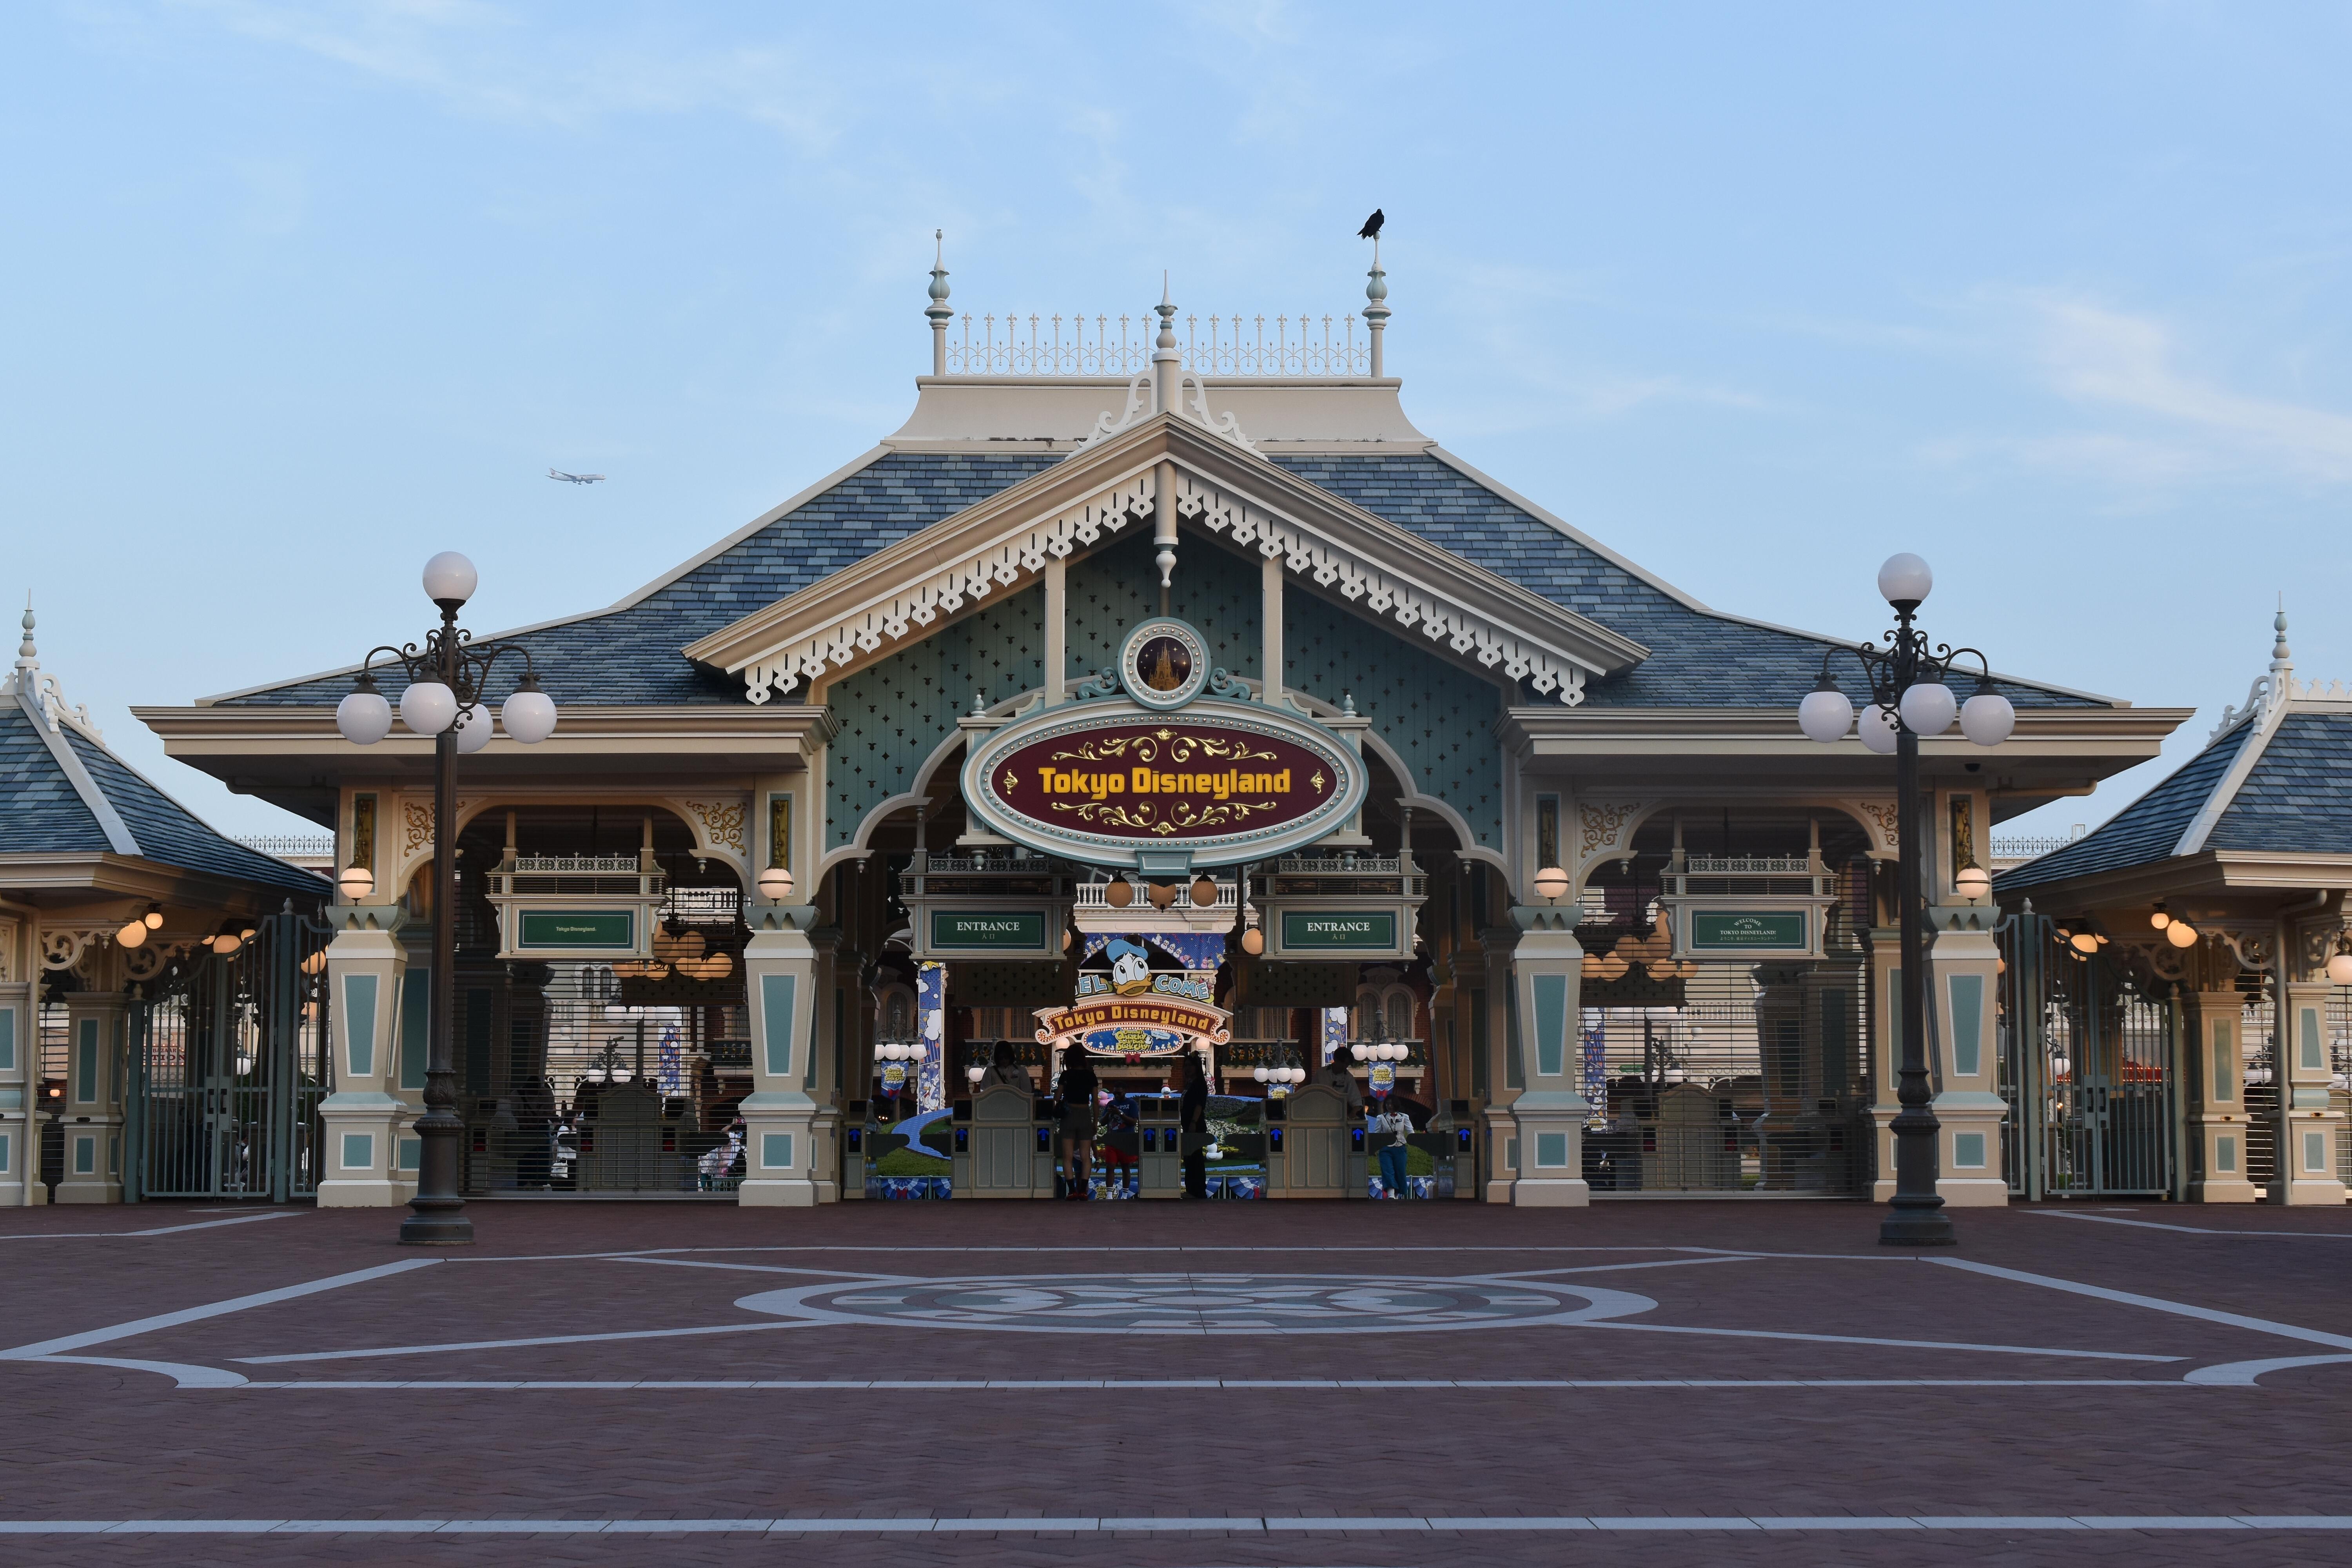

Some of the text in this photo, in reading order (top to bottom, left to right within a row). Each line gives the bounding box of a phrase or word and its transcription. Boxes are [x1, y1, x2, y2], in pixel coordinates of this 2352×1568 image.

[1038, 767, 1290, 799] Tokyo Disneyland
[956, 922, 1020, 931] ENTRANCE
[1307, 922, 1370, 931] ENTRANCE
[1734, 918, 1762, 927] WELCOME
[1075, 974, 1209, 1000] EL COME
[1054, 1005, 1209, 1031] Tokyo Disneyland
[1116, 1031, 1147, 1040] Quacky
